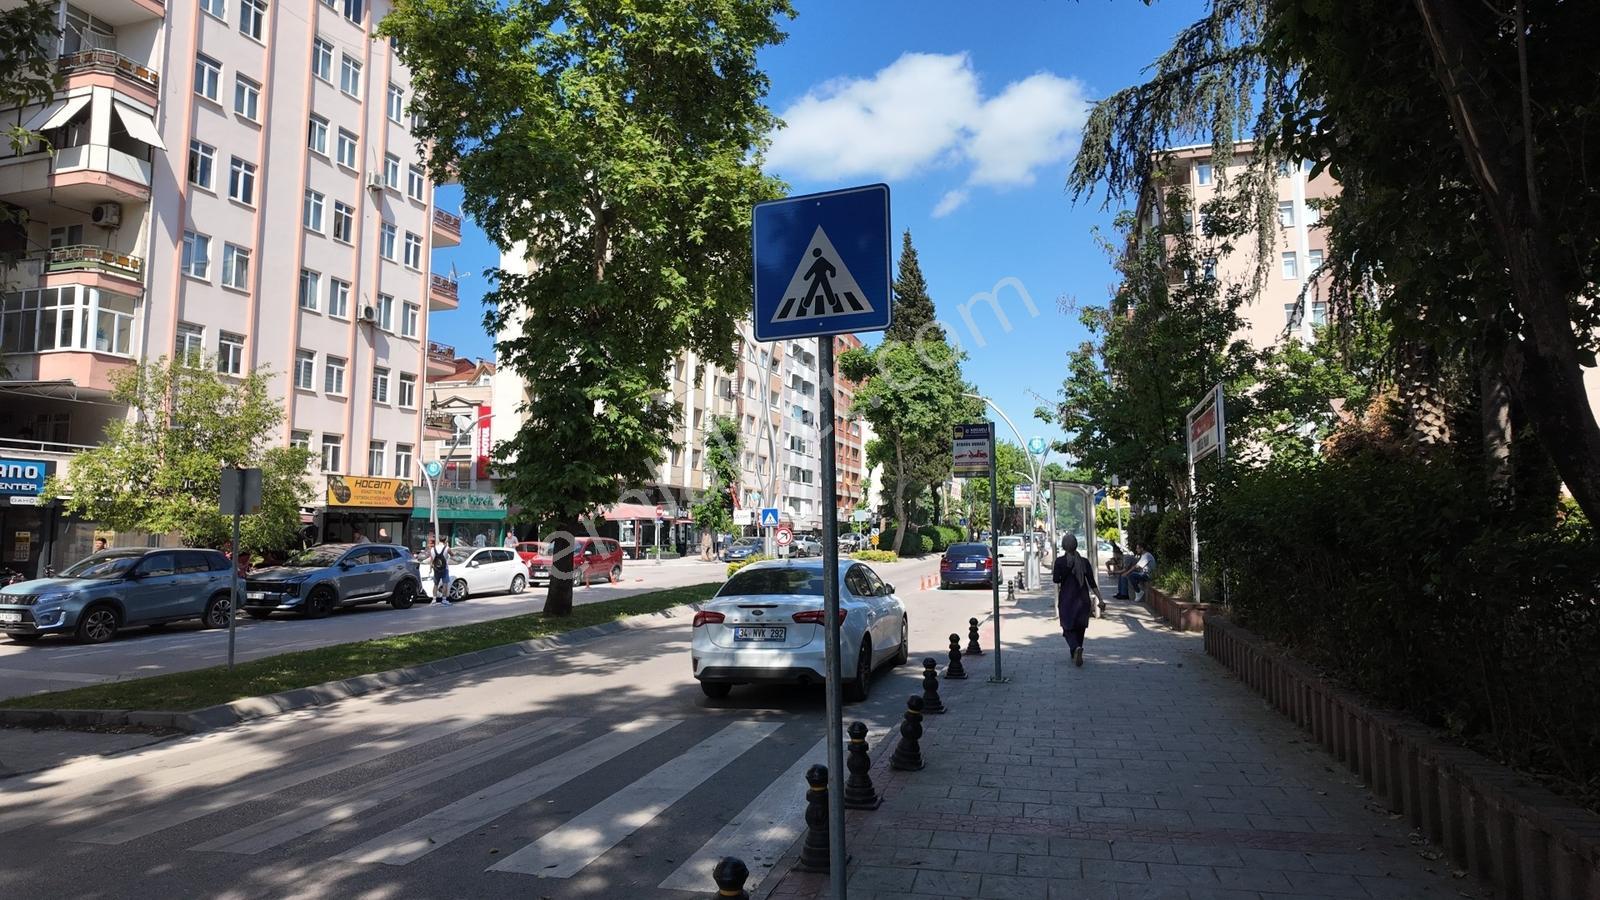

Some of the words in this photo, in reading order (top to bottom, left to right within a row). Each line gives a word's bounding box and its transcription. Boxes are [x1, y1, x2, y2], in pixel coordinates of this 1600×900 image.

[740, 629, 748, 637] 34
[753, 629, 766, 637] NVK
[770, 629, 784, 638] 292
